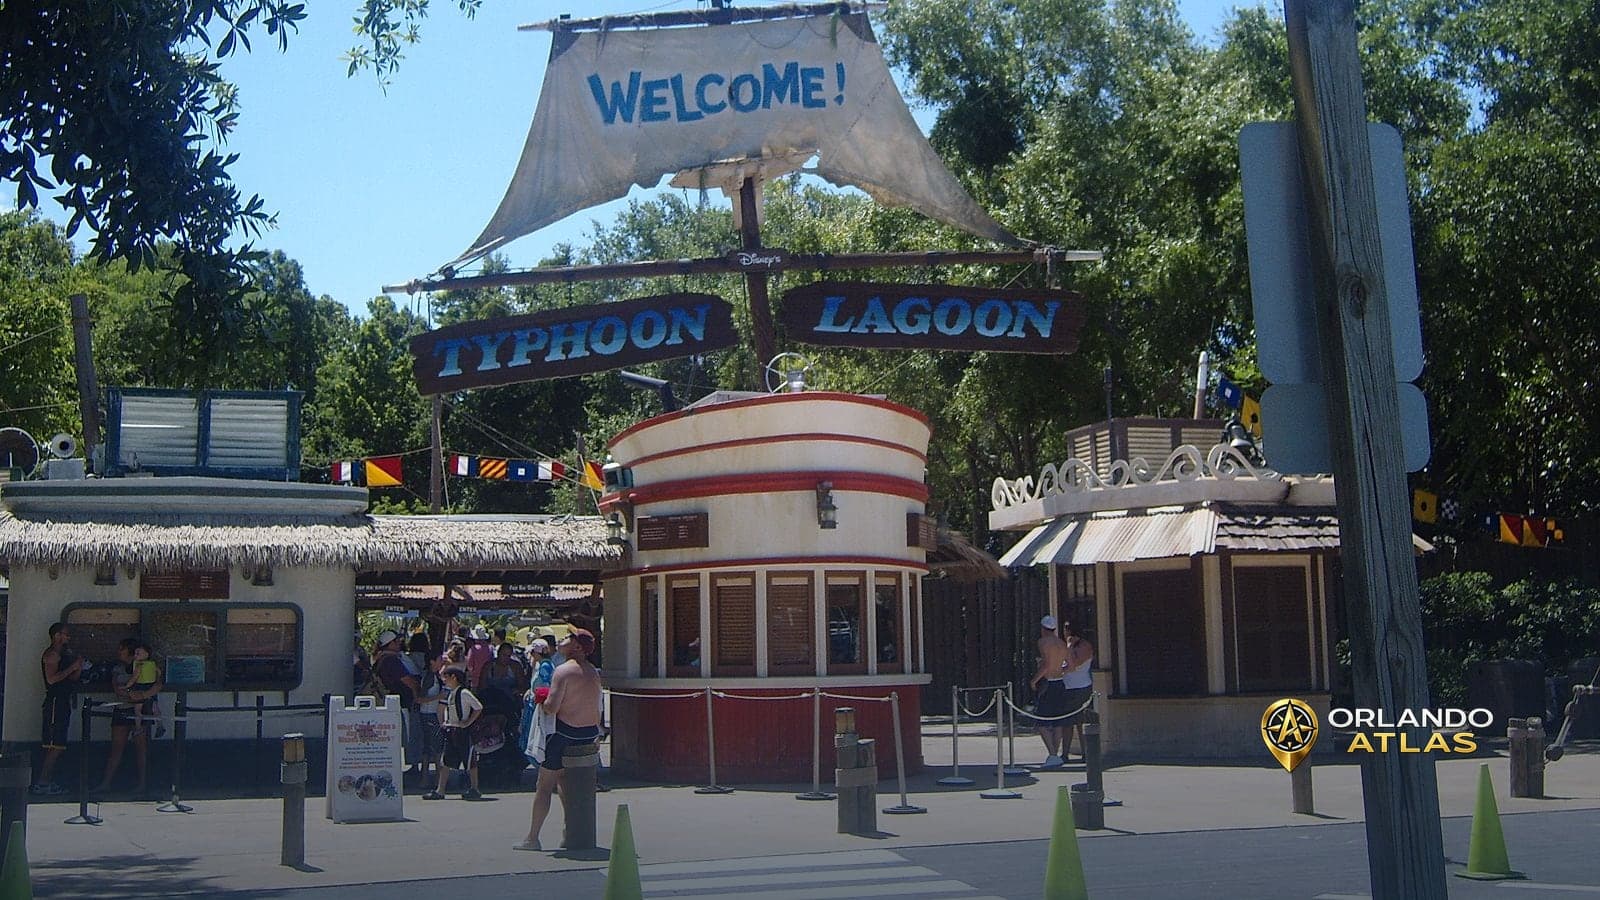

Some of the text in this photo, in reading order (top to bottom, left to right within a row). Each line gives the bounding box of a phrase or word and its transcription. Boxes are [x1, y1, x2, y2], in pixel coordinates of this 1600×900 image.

[587, 61, 846, 125] WELCOME!
[736, 252, 782, 268] Disney's
[431, 303, 712, 378] TYPHOON
[812, 295, 1062, 339] LAGOON
